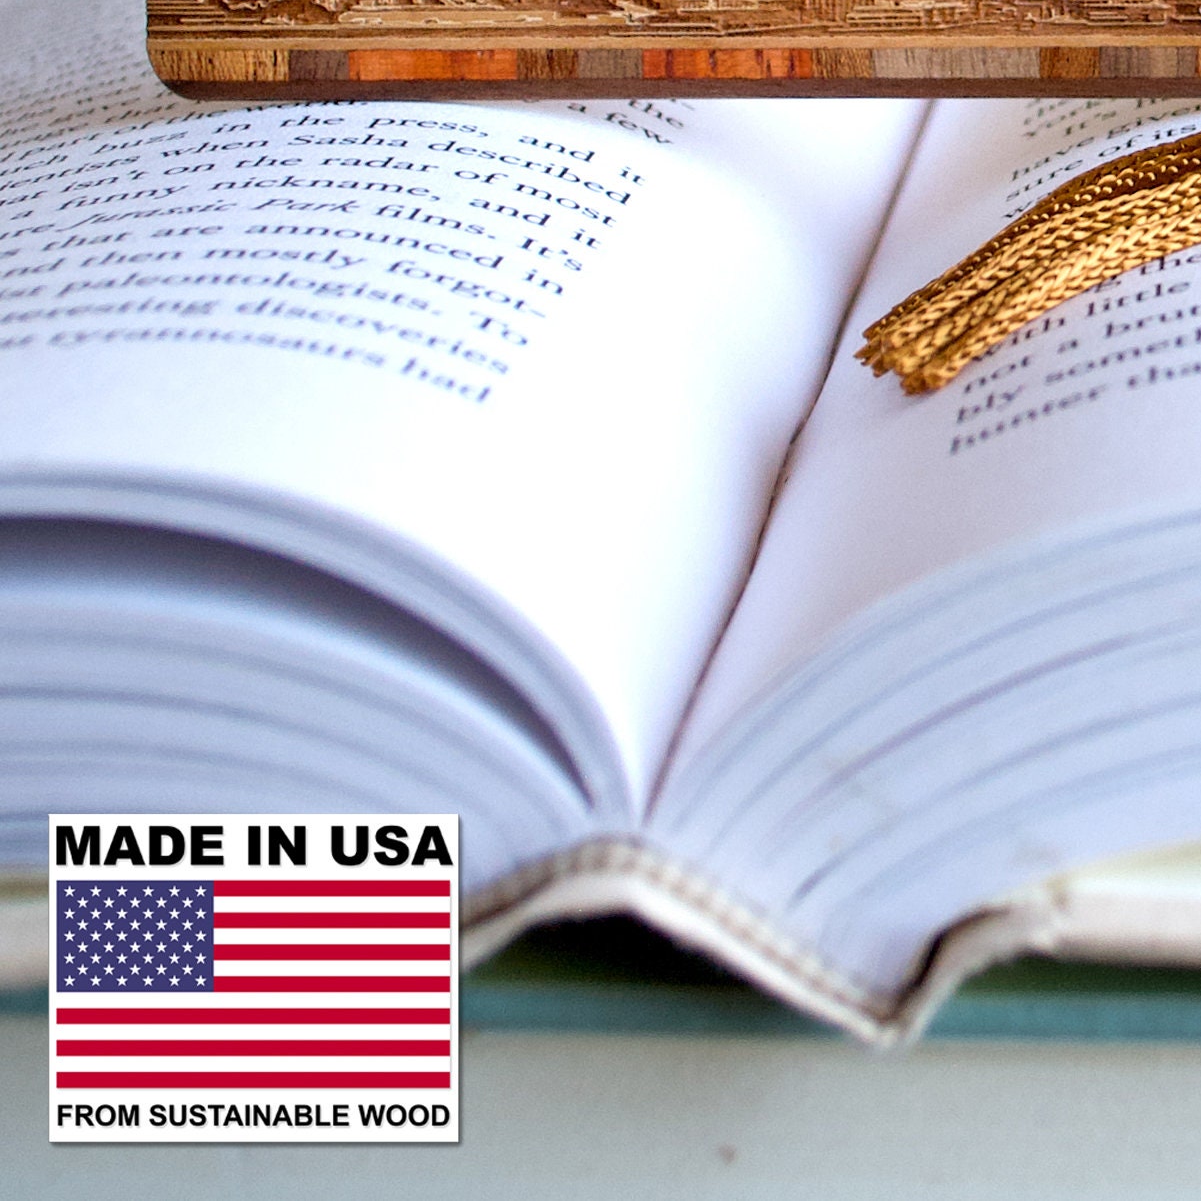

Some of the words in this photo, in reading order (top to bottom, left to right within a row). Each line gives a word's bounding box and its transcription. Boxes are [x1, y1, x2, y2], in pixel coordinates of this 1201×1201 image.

[90, 130, 190, 156] buzz
[212, 122, 252, 135] in
[279, 115, 345, 129] the
[364, 116, 489, 138] press,
[517, 135, 596, 163] and
[618, 166, 647, 186] it
[112, 119, 154, 136] of
[166, 107, 230, 126] the
[566, 101, 588, 115] a
[603, 111, 675, 145] few
[60, 169, 151, 194] isn't
[163, 163, 216, 176] on
[234, 155, 303, 169] the
[320, 156, 440, 173] radar
[453, 169, 511, 185] of
[513, 182, 617, 228] most
[160, 139, 270, 158] when
[287, 134, 409, 148] Sasha
[427, 140, 632, 206] described
[1005, 158, 1084, 202] sure
[1097, 133, 1144, 158] of
[1153, 123, 1198, 141] its
[1010, 135, 1096, 182] have
[9, 210, 34, 221] a
[55, 184, 190, 212] funny
[207, 175, 441, 202] nickname,
[468, 198, 552, 227] and
[569, 228, 602, 249] it
[55, 199, 239, 233] Jurassic
[250, 198, 361, 213] Park
[372, 204, 497, 240] films.
[516, 236, 583, 271] It's
[41, 231, 132, 252] that
[151, 225, 225, 238] are
[244, 224, 505, 269] announced
[522, 268, 564, 296] in
[79, 250, 184, 268] then
[202, 248, 367, 270] mostly
[386, 259, 547, 318] forgot-
[55, 271, 443, 318] paleontologists.
[467, 310, 529, 346] To
[1085, 280, 1191, 318] little
[48, 329, 387, 368] tyrannosaurs
[399, 357, 492, 404] had
[234, 298, 509, 375] discoveries
[963, 354, 1031, 394] not
[1056, 338, 1080, 354] a
[950, 383, 1108, 455] hunter
[954, 385, 1026, 425] bly
